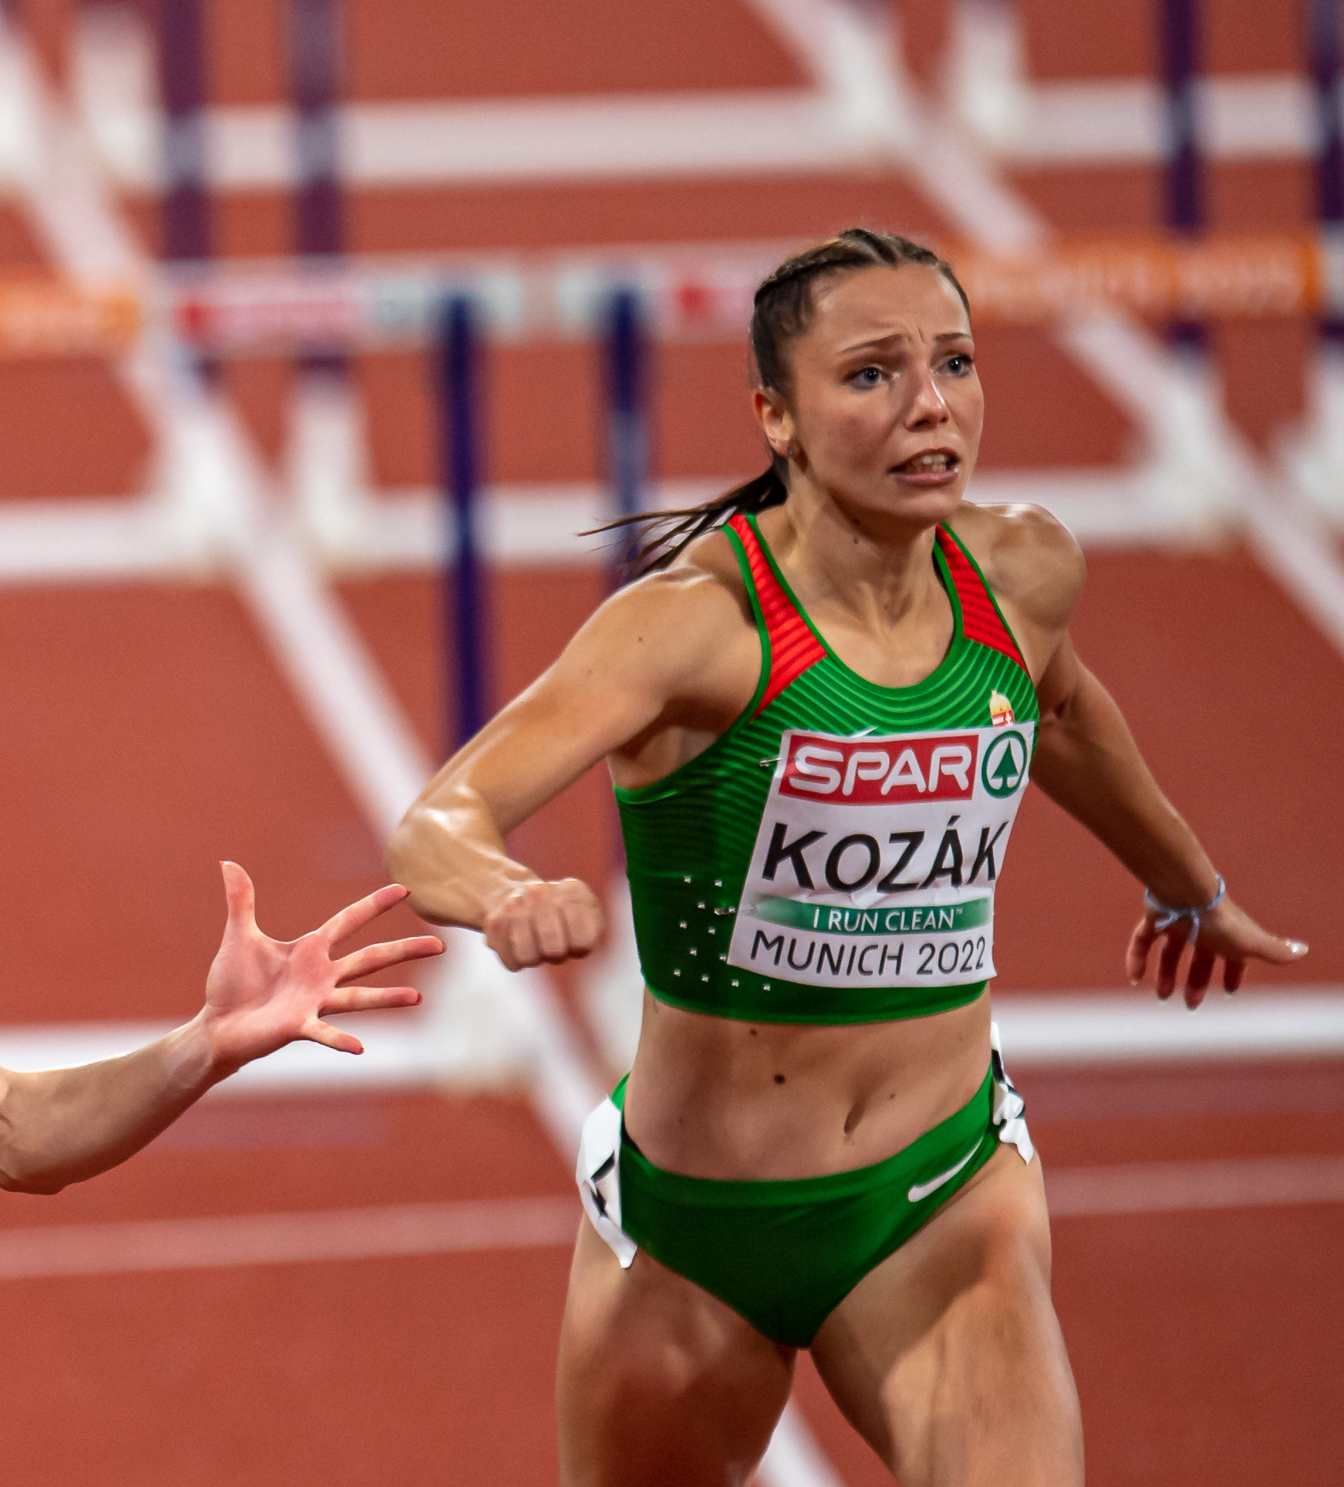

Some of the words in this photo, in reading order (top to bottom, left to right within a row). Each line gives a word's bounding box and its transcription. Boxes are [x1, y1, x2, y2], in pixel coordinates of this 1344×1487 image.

[789, 745, 972, 796] SPAR
[762, 815, 1009, 893] KOZÁK
[813, 908, 820, 929] I
[827, 910, 879, 932] RUN
[750, 930, 904, 976] MUNICH
[917, 937, 986, 976] 2022
